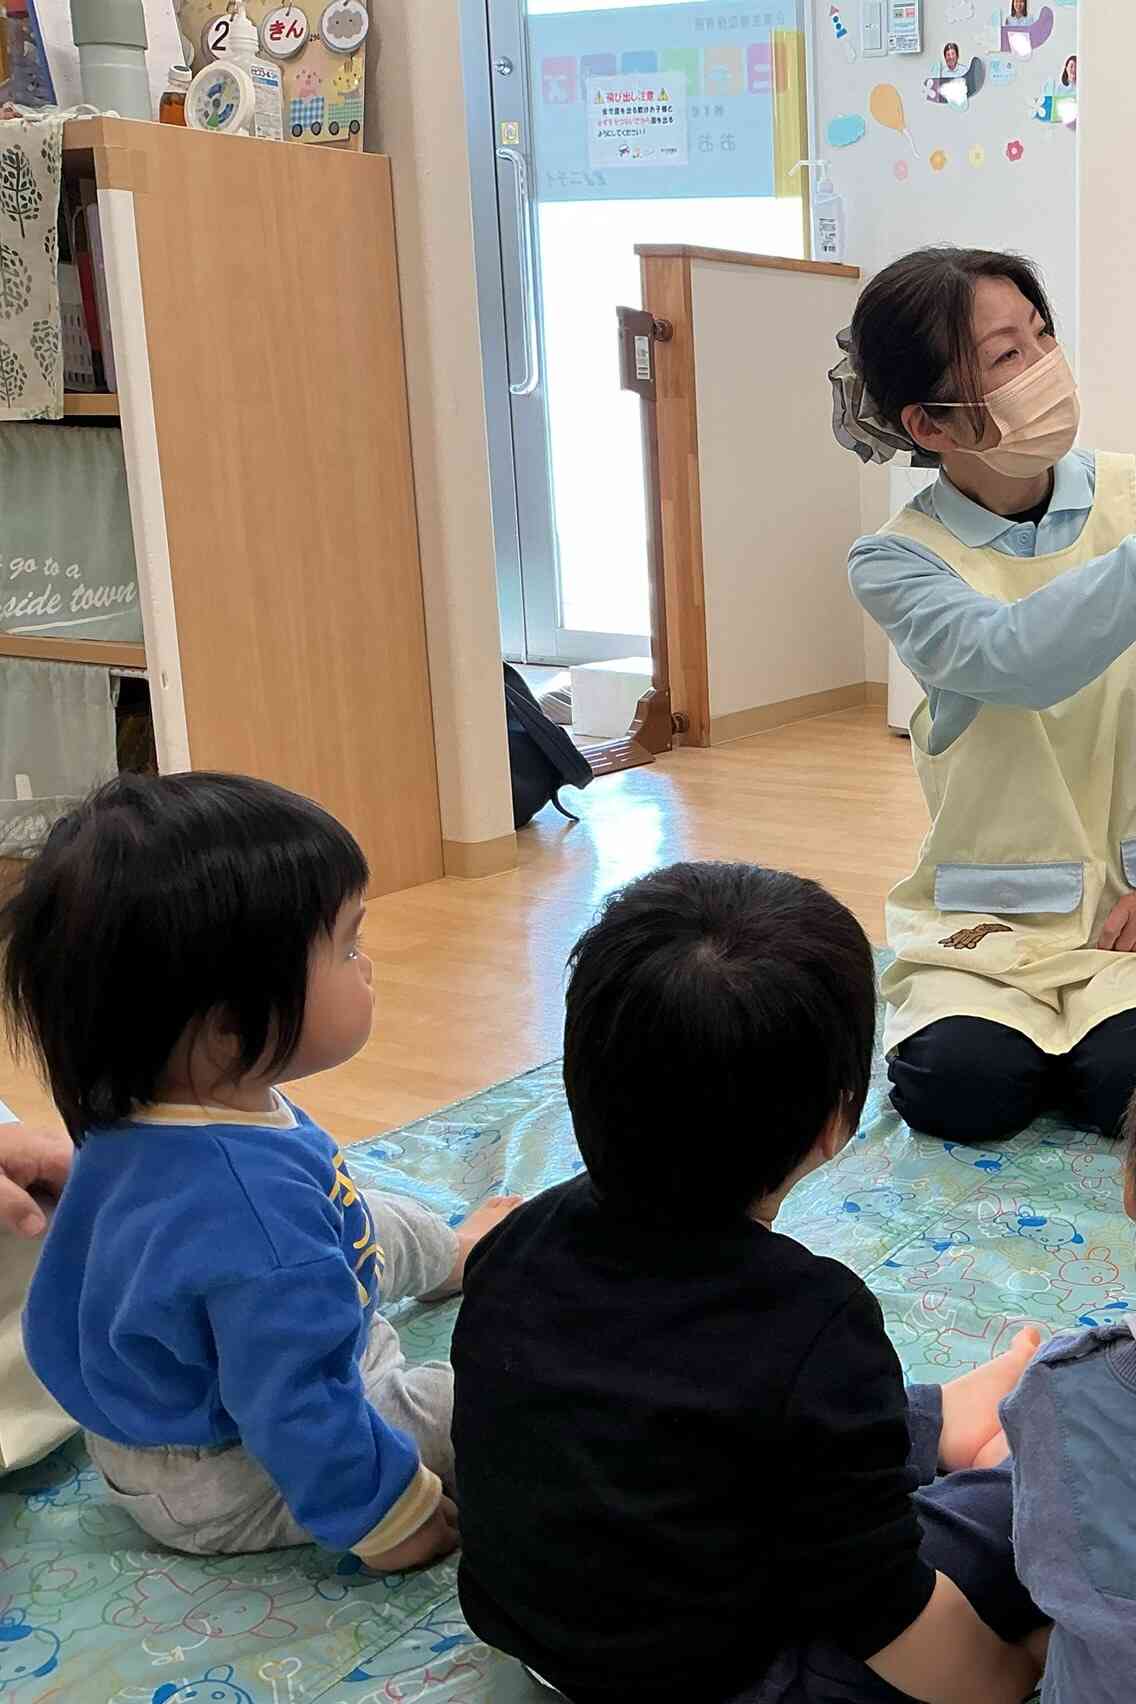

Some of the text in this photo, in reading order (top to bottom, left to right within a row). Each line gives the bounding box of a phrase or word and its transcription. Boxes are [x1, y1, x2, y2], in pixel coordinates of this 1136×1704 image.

[269, 19, 304, 41] きん
[9, 557, 82, 580] go to a
[0, 581, 137, 619] side town
